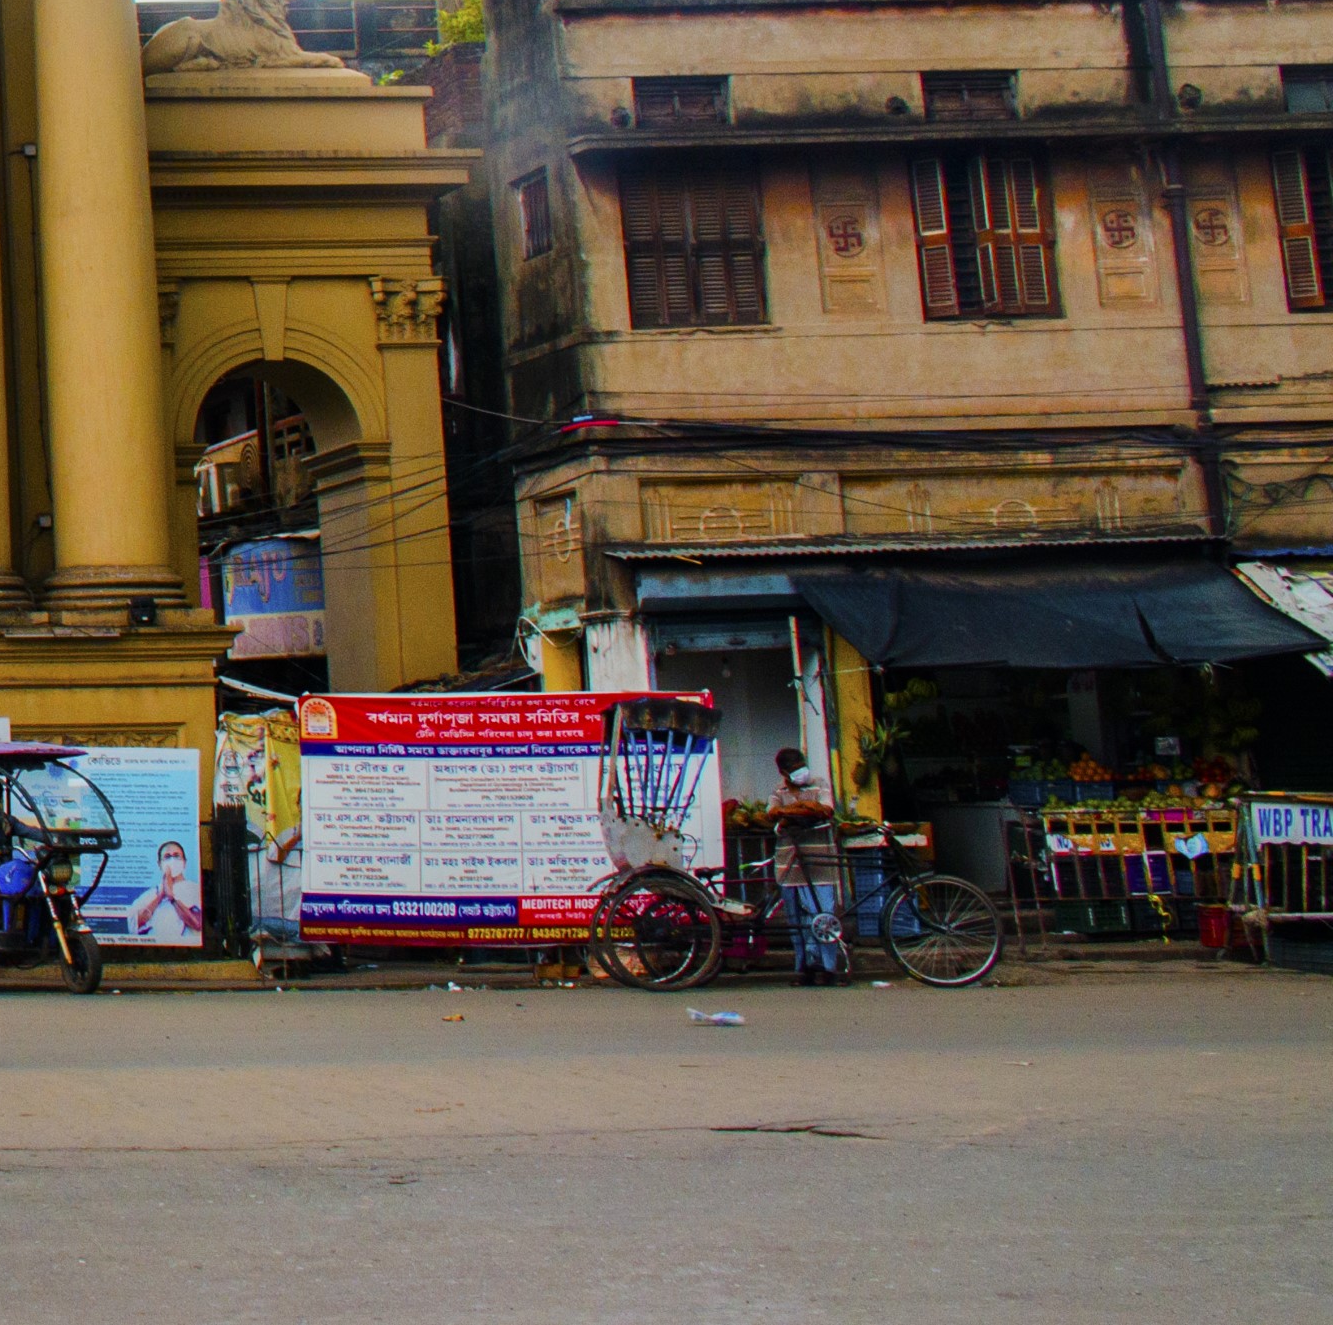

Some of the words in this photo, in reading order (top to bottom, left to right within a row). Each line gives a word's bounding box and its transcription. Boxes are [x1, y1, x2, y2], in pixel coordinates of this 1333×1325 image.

[366, 710, 413, 725] বর্ধমান
[417, 710, 474, 729] দুর্গাপূজা
[525, 708, 580, 724] সমিতির
[1258, 808, 1293, 836] WBP
[392, 901, 456, 916] 9332100209
[521, 898, 572, 909] MEDITECH
